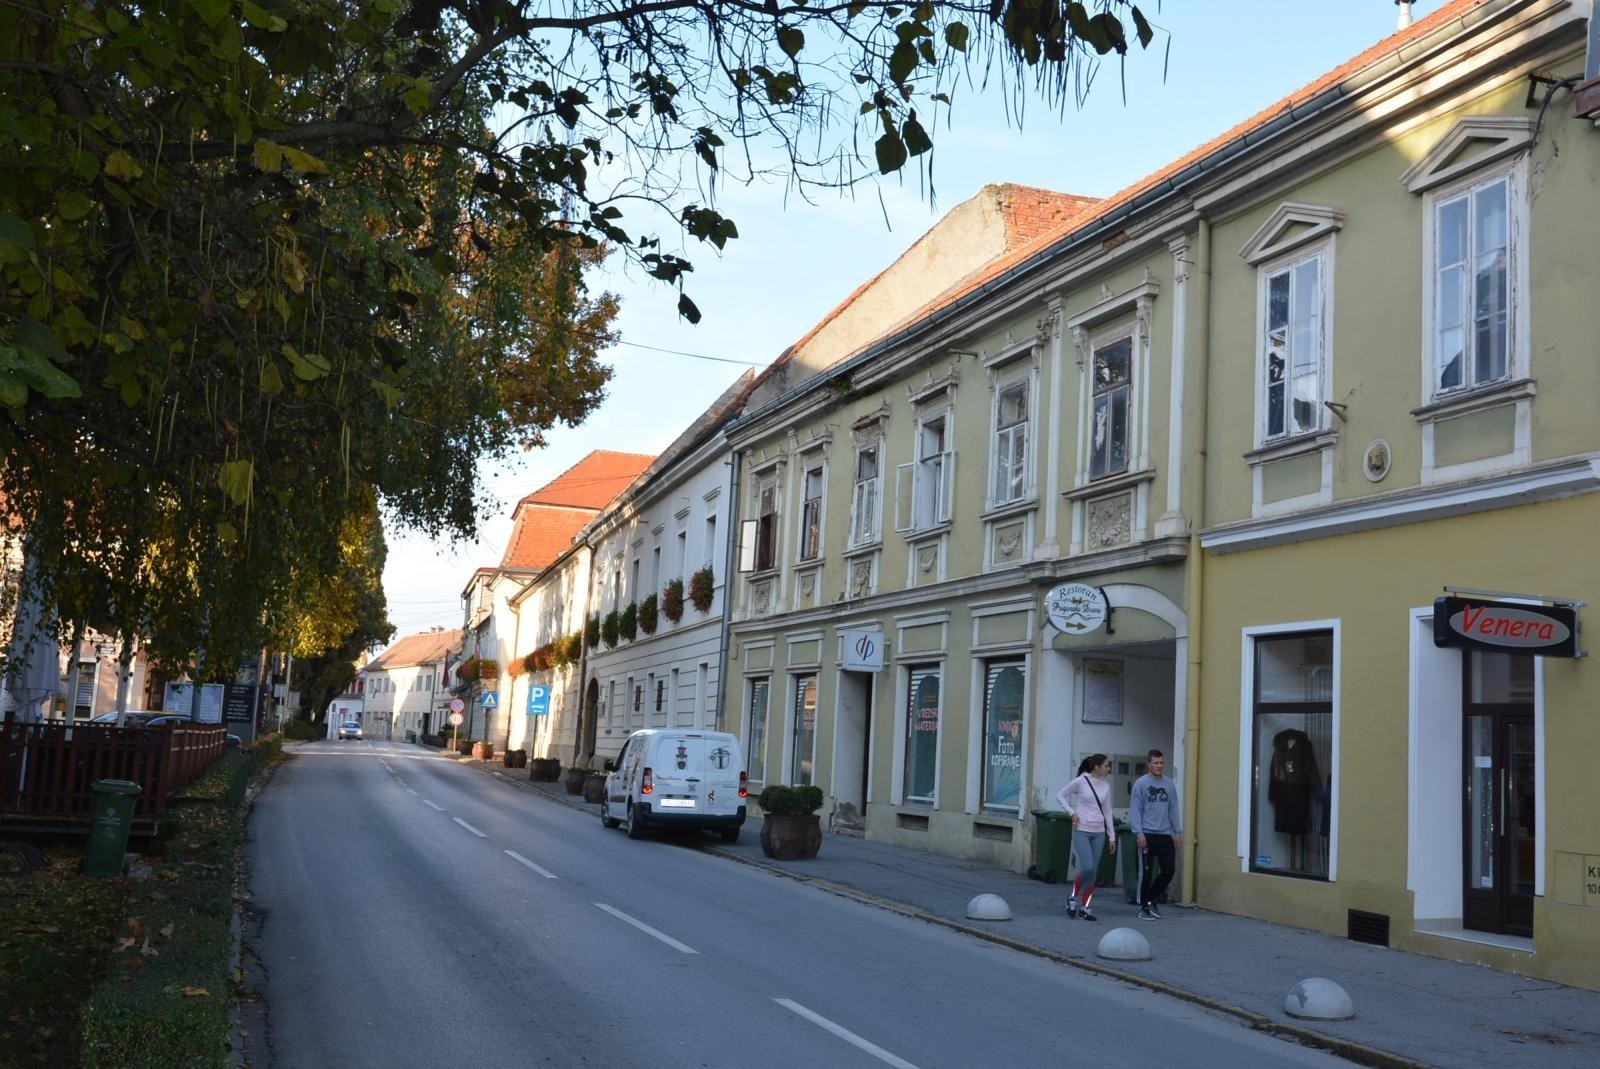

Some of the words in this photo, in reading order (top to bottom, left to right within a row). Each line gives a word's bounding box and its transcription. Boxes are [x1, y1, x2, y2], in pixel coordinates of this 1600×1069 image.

[1059, 585, 1097, 601] Restoran
[1462, 604, 1556, 641] Venera
[531, 687, 544, 702] P
